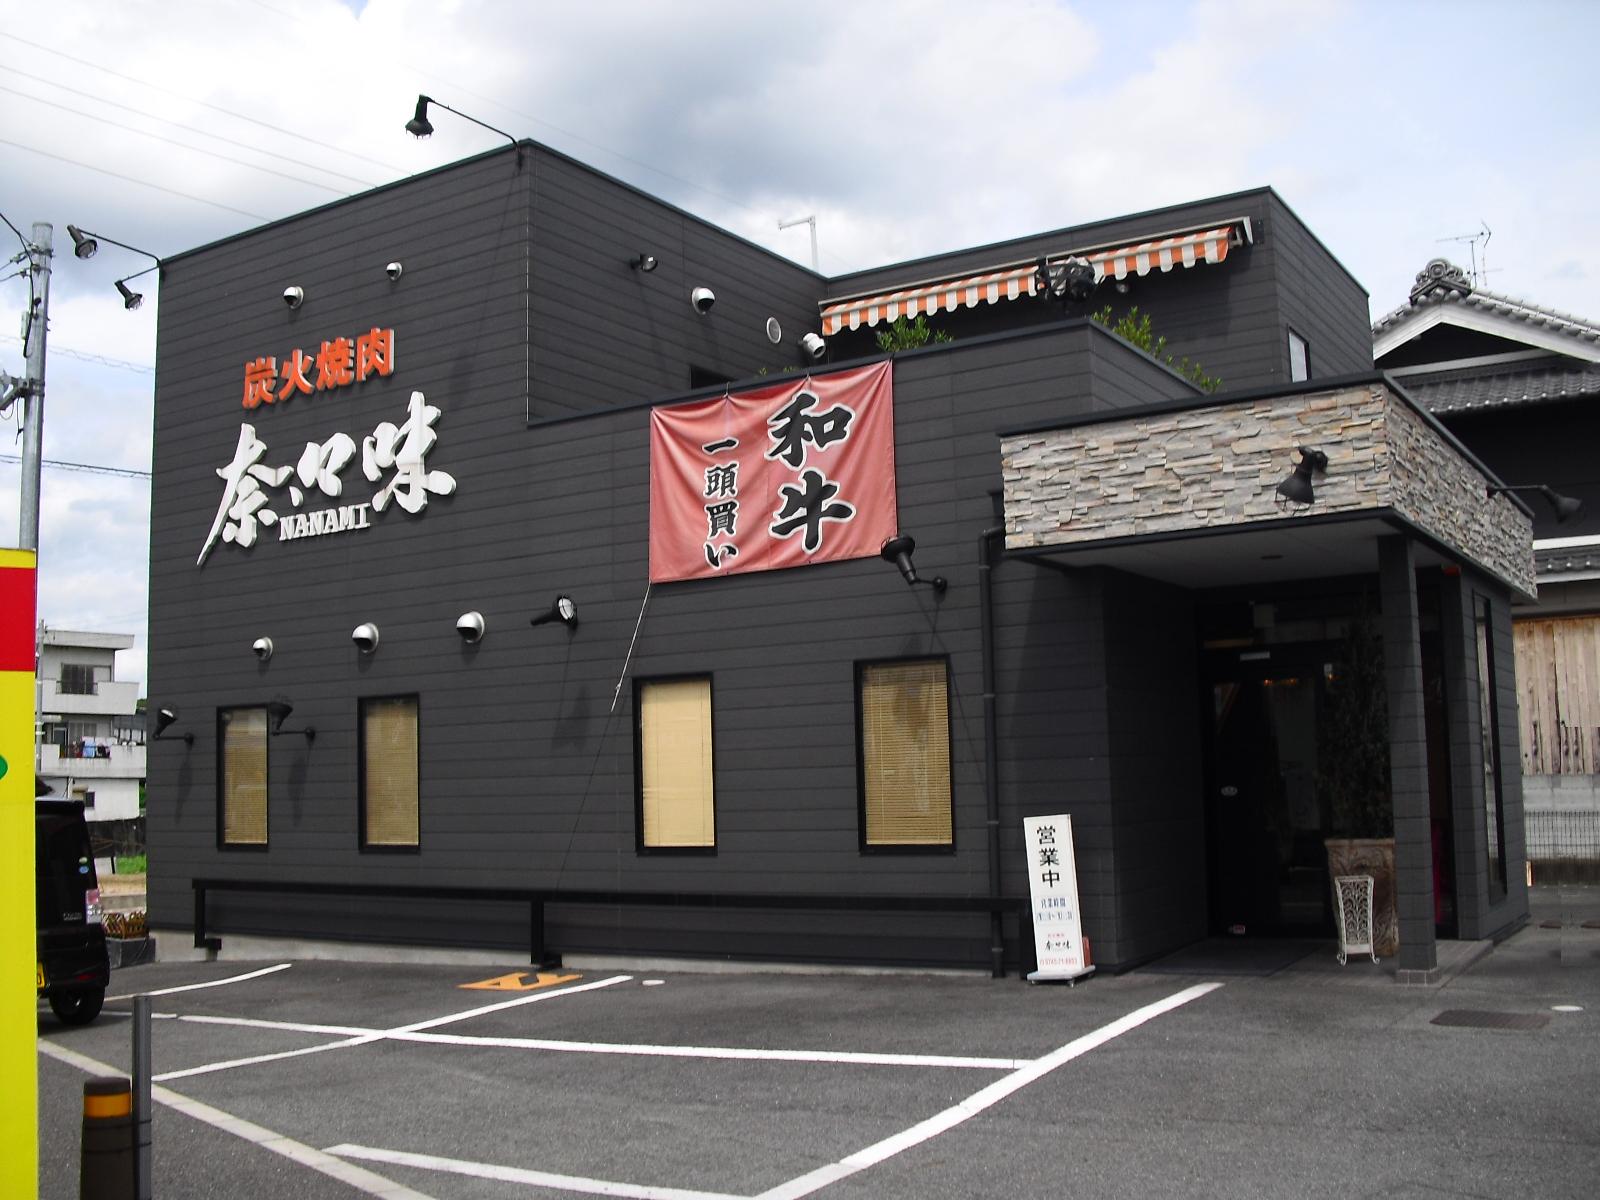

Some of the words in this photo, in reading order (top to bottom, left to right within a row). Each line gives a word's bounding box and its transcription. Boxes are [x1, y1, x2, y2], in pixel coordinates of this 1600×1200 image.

[242, 327, 395, 409] 炭火焼肉
[197, 391, 457, 566] 奈々味
[279, 502, 371, 541] NANAMI
[702, 437, 739, 568] 一頭買い
[763, 391, 855, 553] 和牛
[1036, 825, 1061, 888] 営業中
